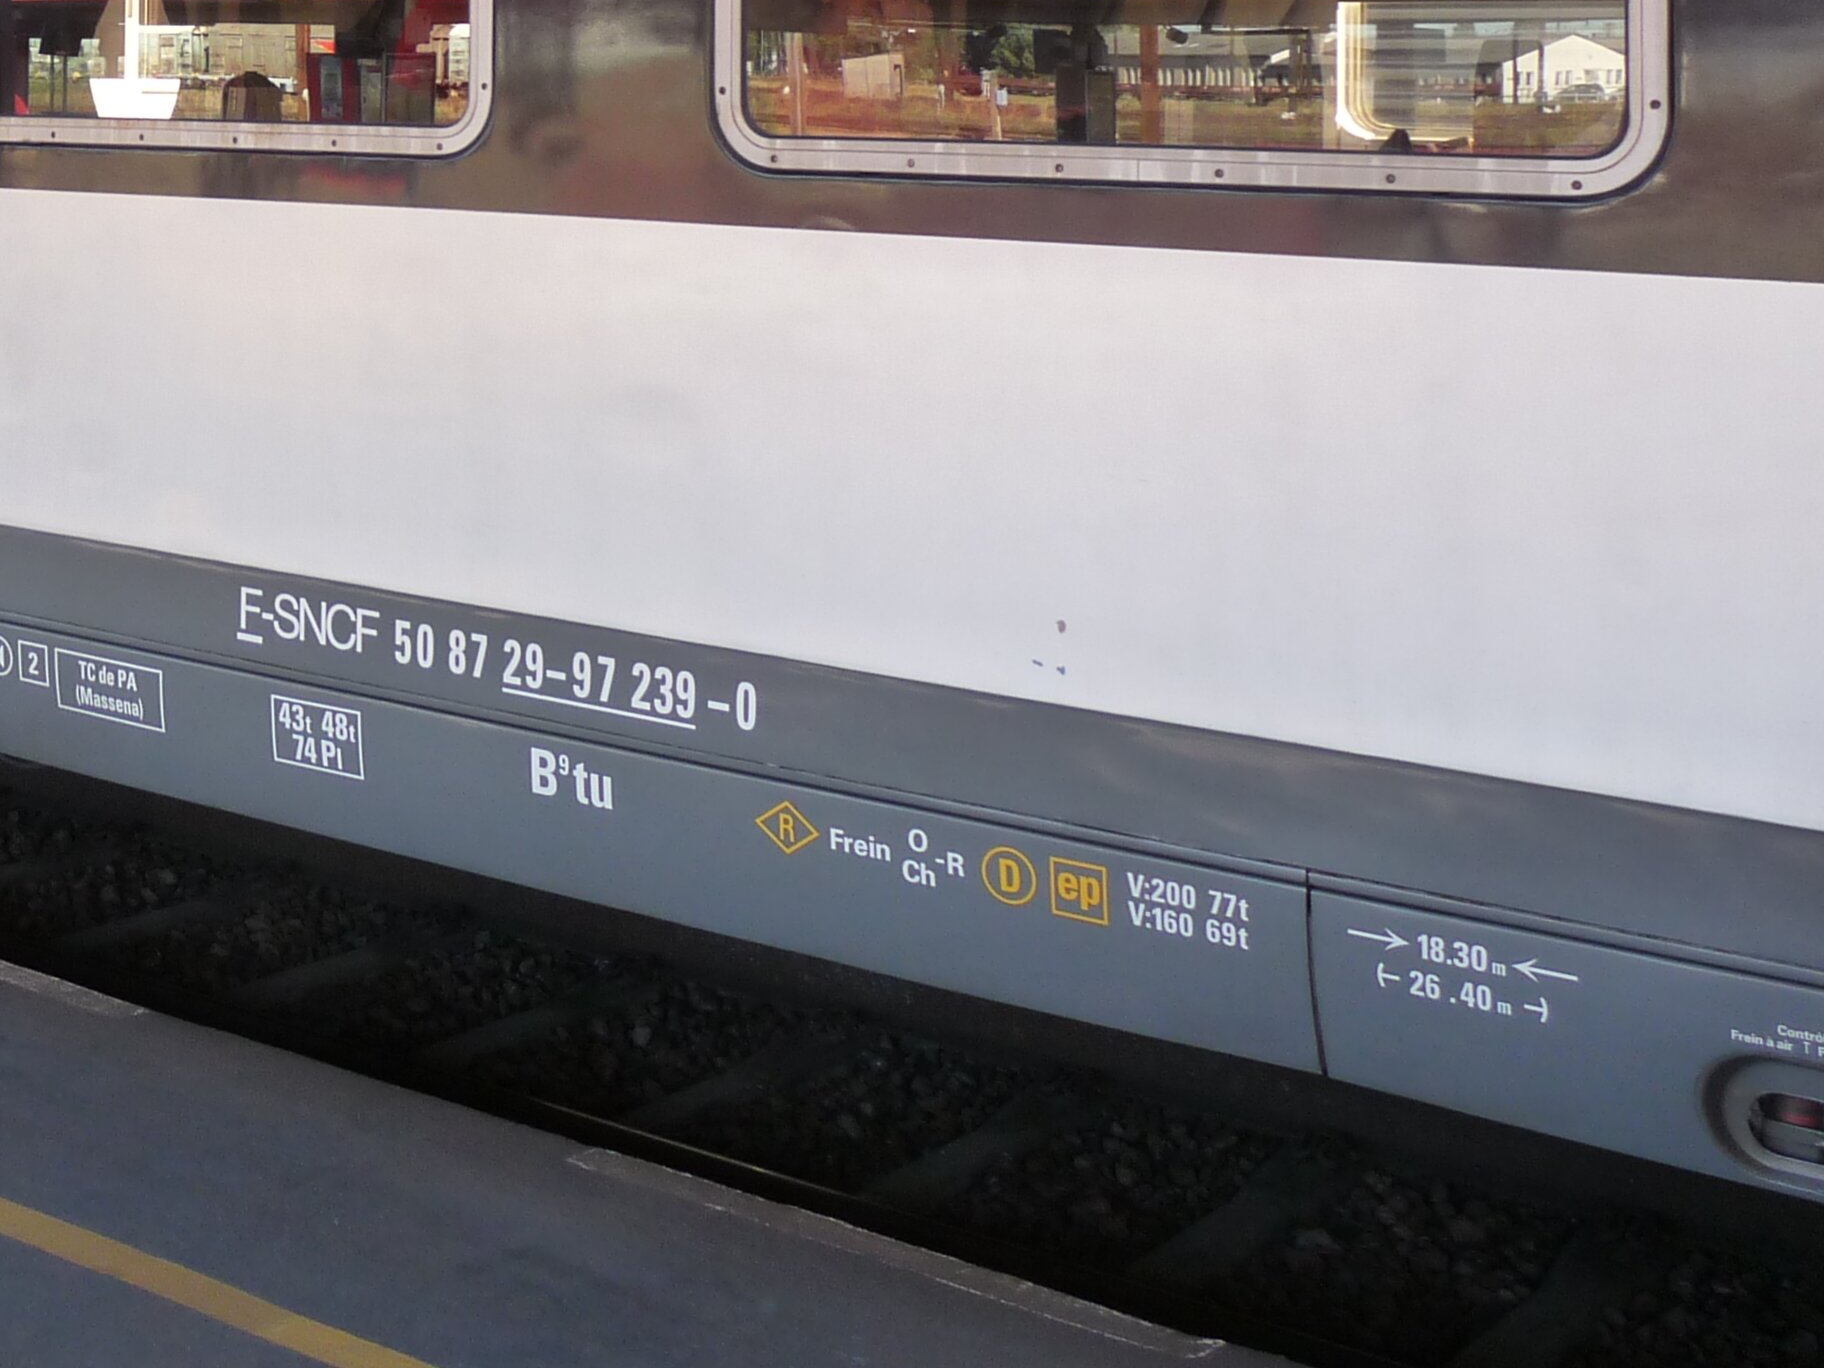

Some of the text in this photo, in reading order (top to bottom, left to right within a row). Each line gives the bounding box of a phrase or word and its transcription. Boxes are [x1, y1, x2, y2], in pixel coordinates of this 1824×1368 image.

[28, 652, 39, 675] 2
[237, 586, 380, 653] F-SNCF
[394, 619, 434, 669] 50
[448, 629, 488, 678] 87
[502, 638, 616, 703] 29-97
[631, 662, 696, 719] 239
[78, 660, 138, 692] TC de PA
[76, 684, 143, 721] (Massena)
[278, 702, 356, 743] 43t 48t
[292, 734, 318, 764] 74
[778, 812, 795, 844] R
[829, 827, 891, 862] Frein
[902, 859, 937, 887] Ch
[998, 857, 1021, 894] D
[1057, 870, 1101, 911] ep
[1126, 871, 1250, 922] V:200 77t
[1127, 900, 1250, 950] V:160 69t
[1417, 934, 1507, 977] 18.30 m
[1497, 1001, 1513, 1016] m
[1730, 1028, 1764, 1045] Frein
[1776, 1039, 1794, 1051] air
